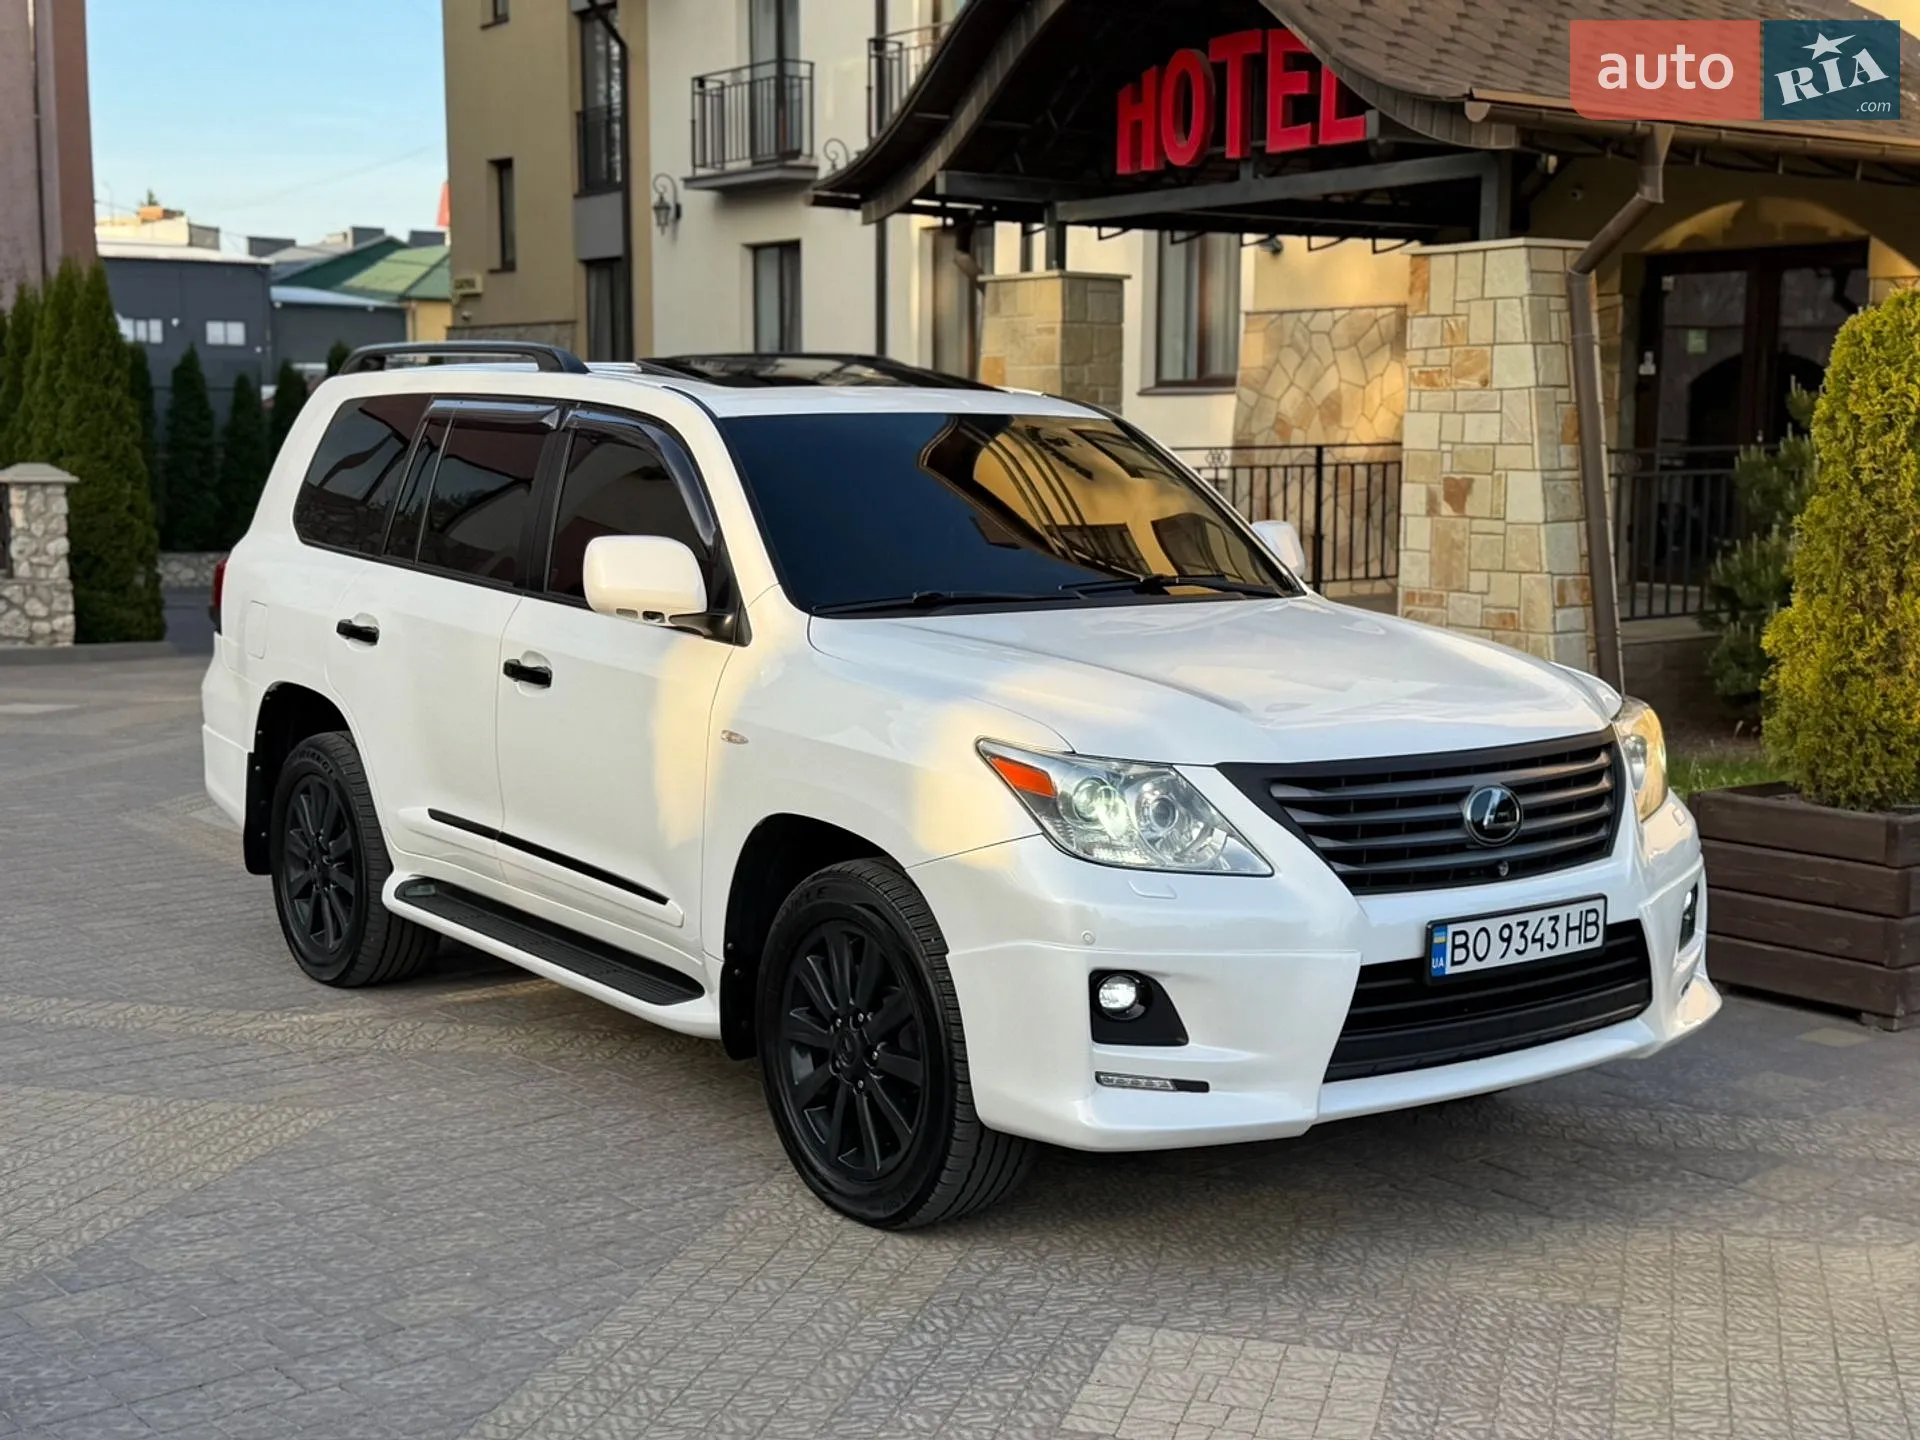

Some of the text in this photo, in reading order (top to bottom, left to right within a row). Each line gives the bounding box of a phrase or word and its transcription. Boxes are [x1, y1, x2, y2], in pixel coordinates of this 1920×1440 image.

[1116, 29, 1367, 175] HOTEL
[1431, 957, 1445, 969] UA
[1450, 907, 1601, 967] BO 9343 HB
